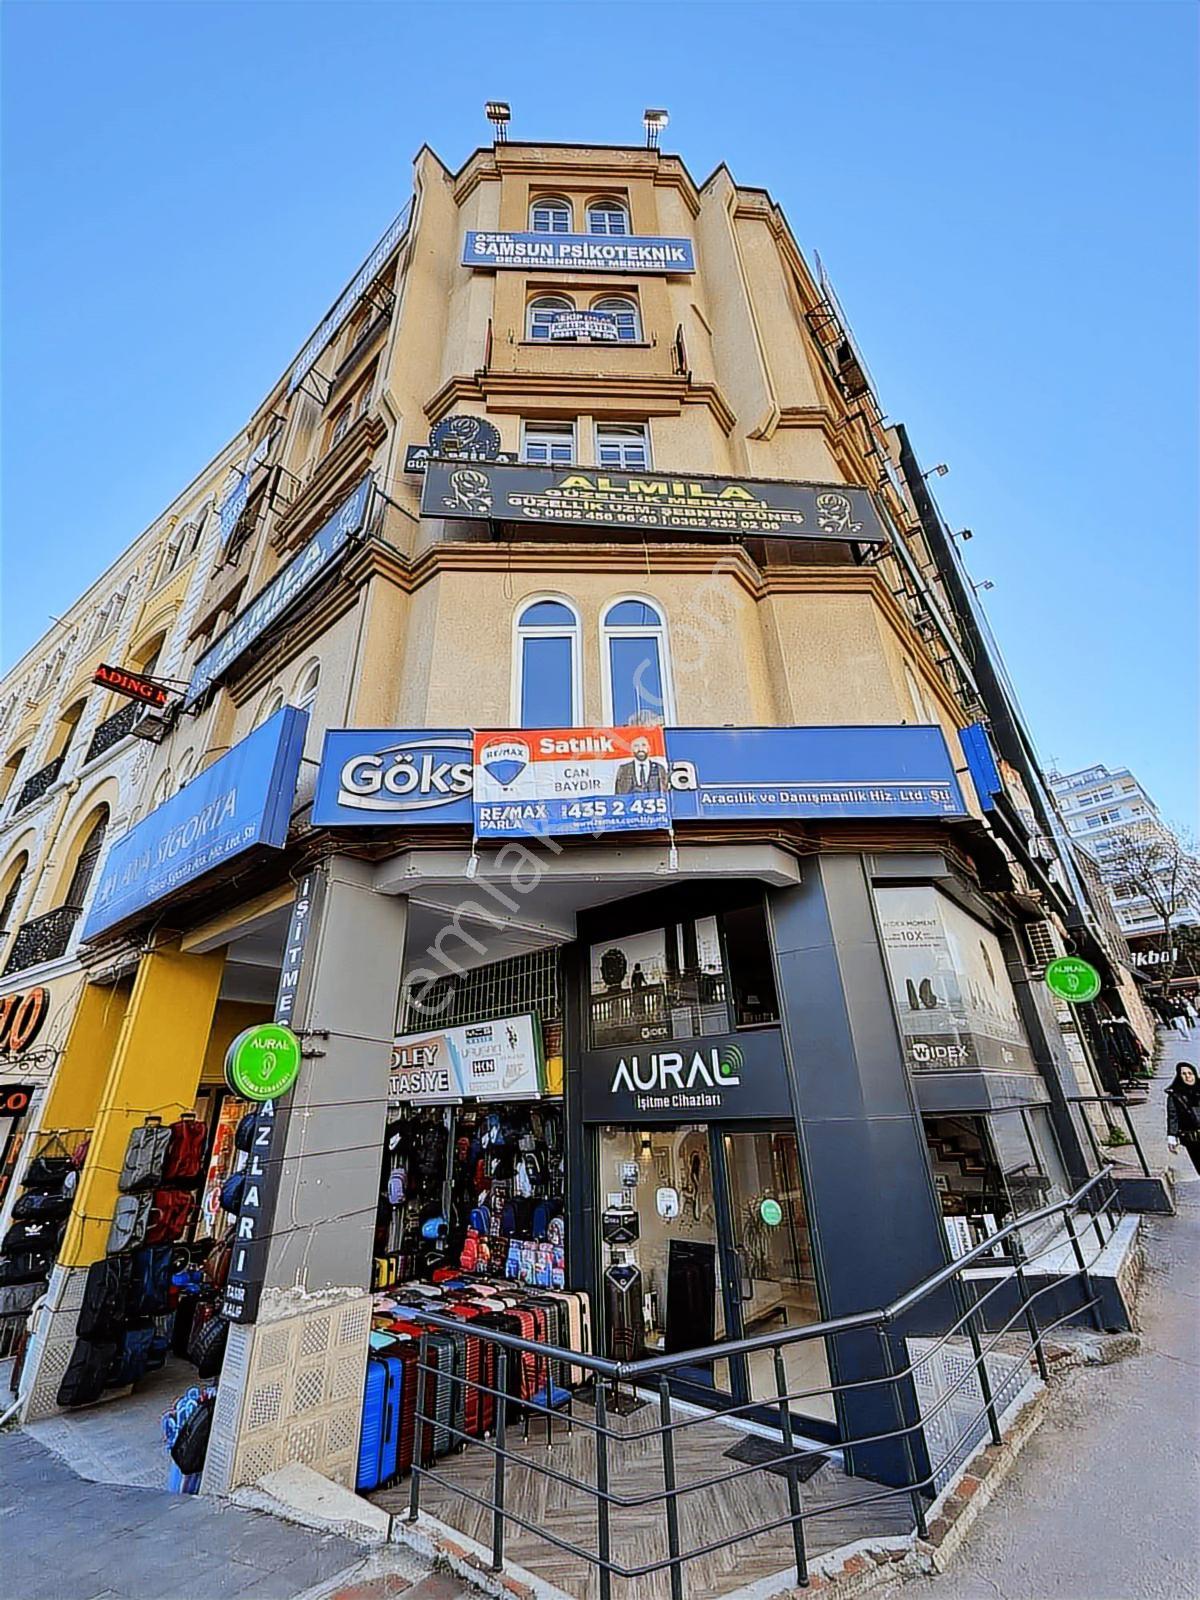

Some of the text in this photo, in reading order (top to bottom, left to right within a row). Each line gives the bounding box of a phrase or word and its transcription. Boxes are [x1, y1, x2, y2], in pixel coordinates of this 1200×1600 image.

[474, 241, 686, 262] SAMSUN PSİKOTEKNİK
[558, 474, 756, 500] ALMİLA
[545, 487, 768, 509] GÜZELLİK MERKEZİ
[508, 495, 605, 513] GÜZELLİK
[608, 503, 656, 514] UZM.
[741, 508, 804, 524] GÜNEŞ
[711, 518, 738, 529] 432
[486, 747, 524, 758] RE/MAX
[539, 736, 615, 754] Satılık
[564, 768, 590, 778] CAN
[701, 790, 756, 804] Aracılık
[759, 793, 776, 803] ve
[780, 790, 867, 805] Danışmanlık
[870, 789, 896, 802] Hiz.
[900, 789, 928, 802] Ltd.
[479, 804, 548, 821] RE/MAX
[568, 801, 607, 817] 435
[612, 801, 625, 816] 2
[630, 798, 667, 814] 435
[480, 819, 522, 830] PARLA
[901, 930, 923, 941] 10X
[250, 1037, 290, 1050] AURAL
[912, 1042, 969, 1062] WIDEX
[611, 1048, 740, 1093] AURAL
[388, 1069, 449, 1093] TASİYE
[637, 1091, 722, 1110] İşitme Cihazları
